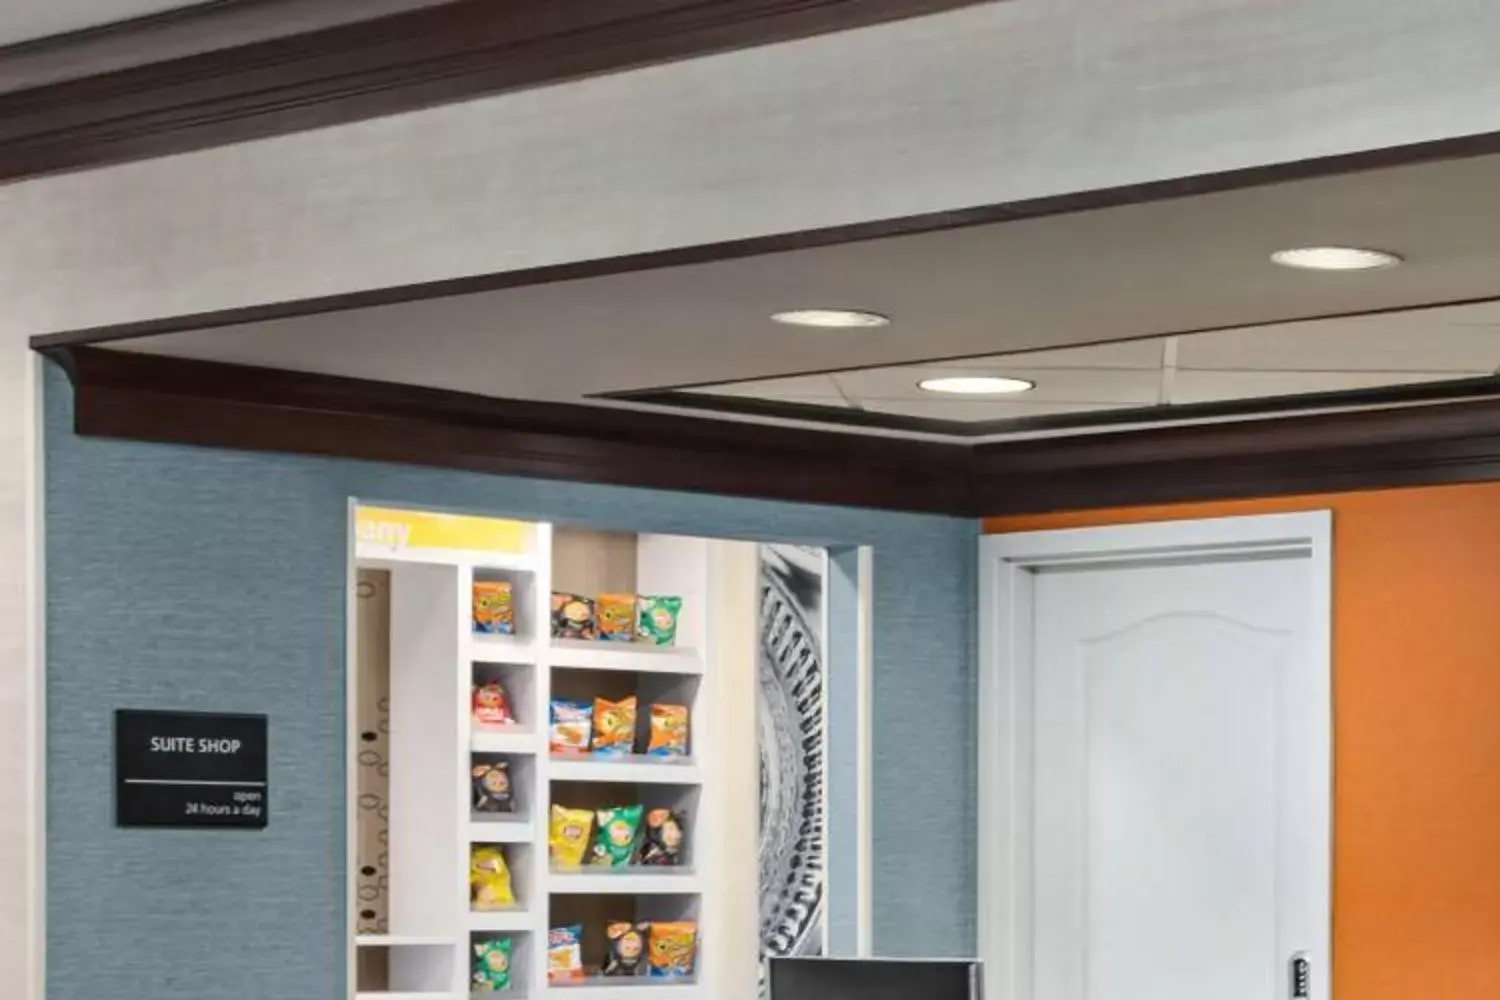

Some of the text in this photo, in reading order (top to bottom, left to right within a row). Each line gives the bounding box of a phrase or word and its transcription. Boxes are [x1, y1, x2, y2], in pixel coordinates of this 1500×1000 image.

[151, 737, 241, 753] SUITE SHOP
[233, 792, 261, 802] open
[185, 803, 261, 818] 24 hours a day
